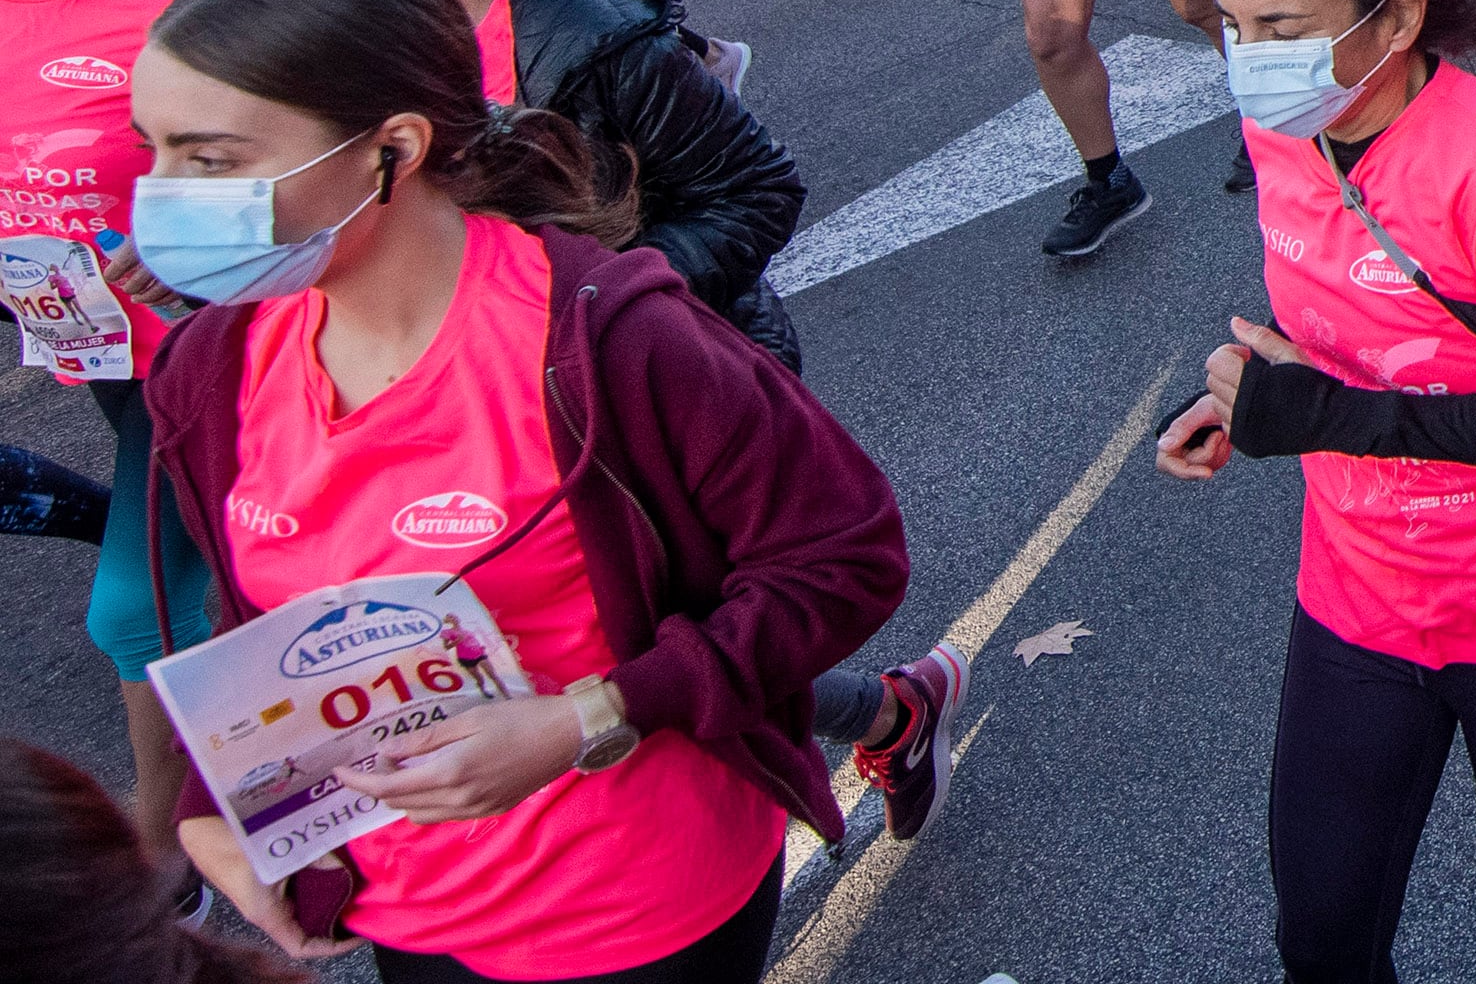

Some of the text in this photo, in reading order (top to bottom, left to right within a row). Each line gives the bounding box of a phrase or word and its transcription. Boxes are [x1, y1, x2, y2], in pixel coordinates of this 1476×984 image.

[45, 65, 121, 85] ASTURIANA
[25, 167, 97, 187] POR
[0, 189, 102, 209] TODAS
[1356, 263, 1412, 283] ASTURIA
[9, 294, 65, 320] 016
[71, 337, 106, 349] MUJER
[1443, 491, 1475, 506] 2021
[400, 512, 498, 535] ASTURIANA
[296, 616, 433, 674] ASTURIANA
[320, 658, 464, 731] 016
[372, 704, 448, 745] 2424
[267, 795, 379, 860] OYSHO
